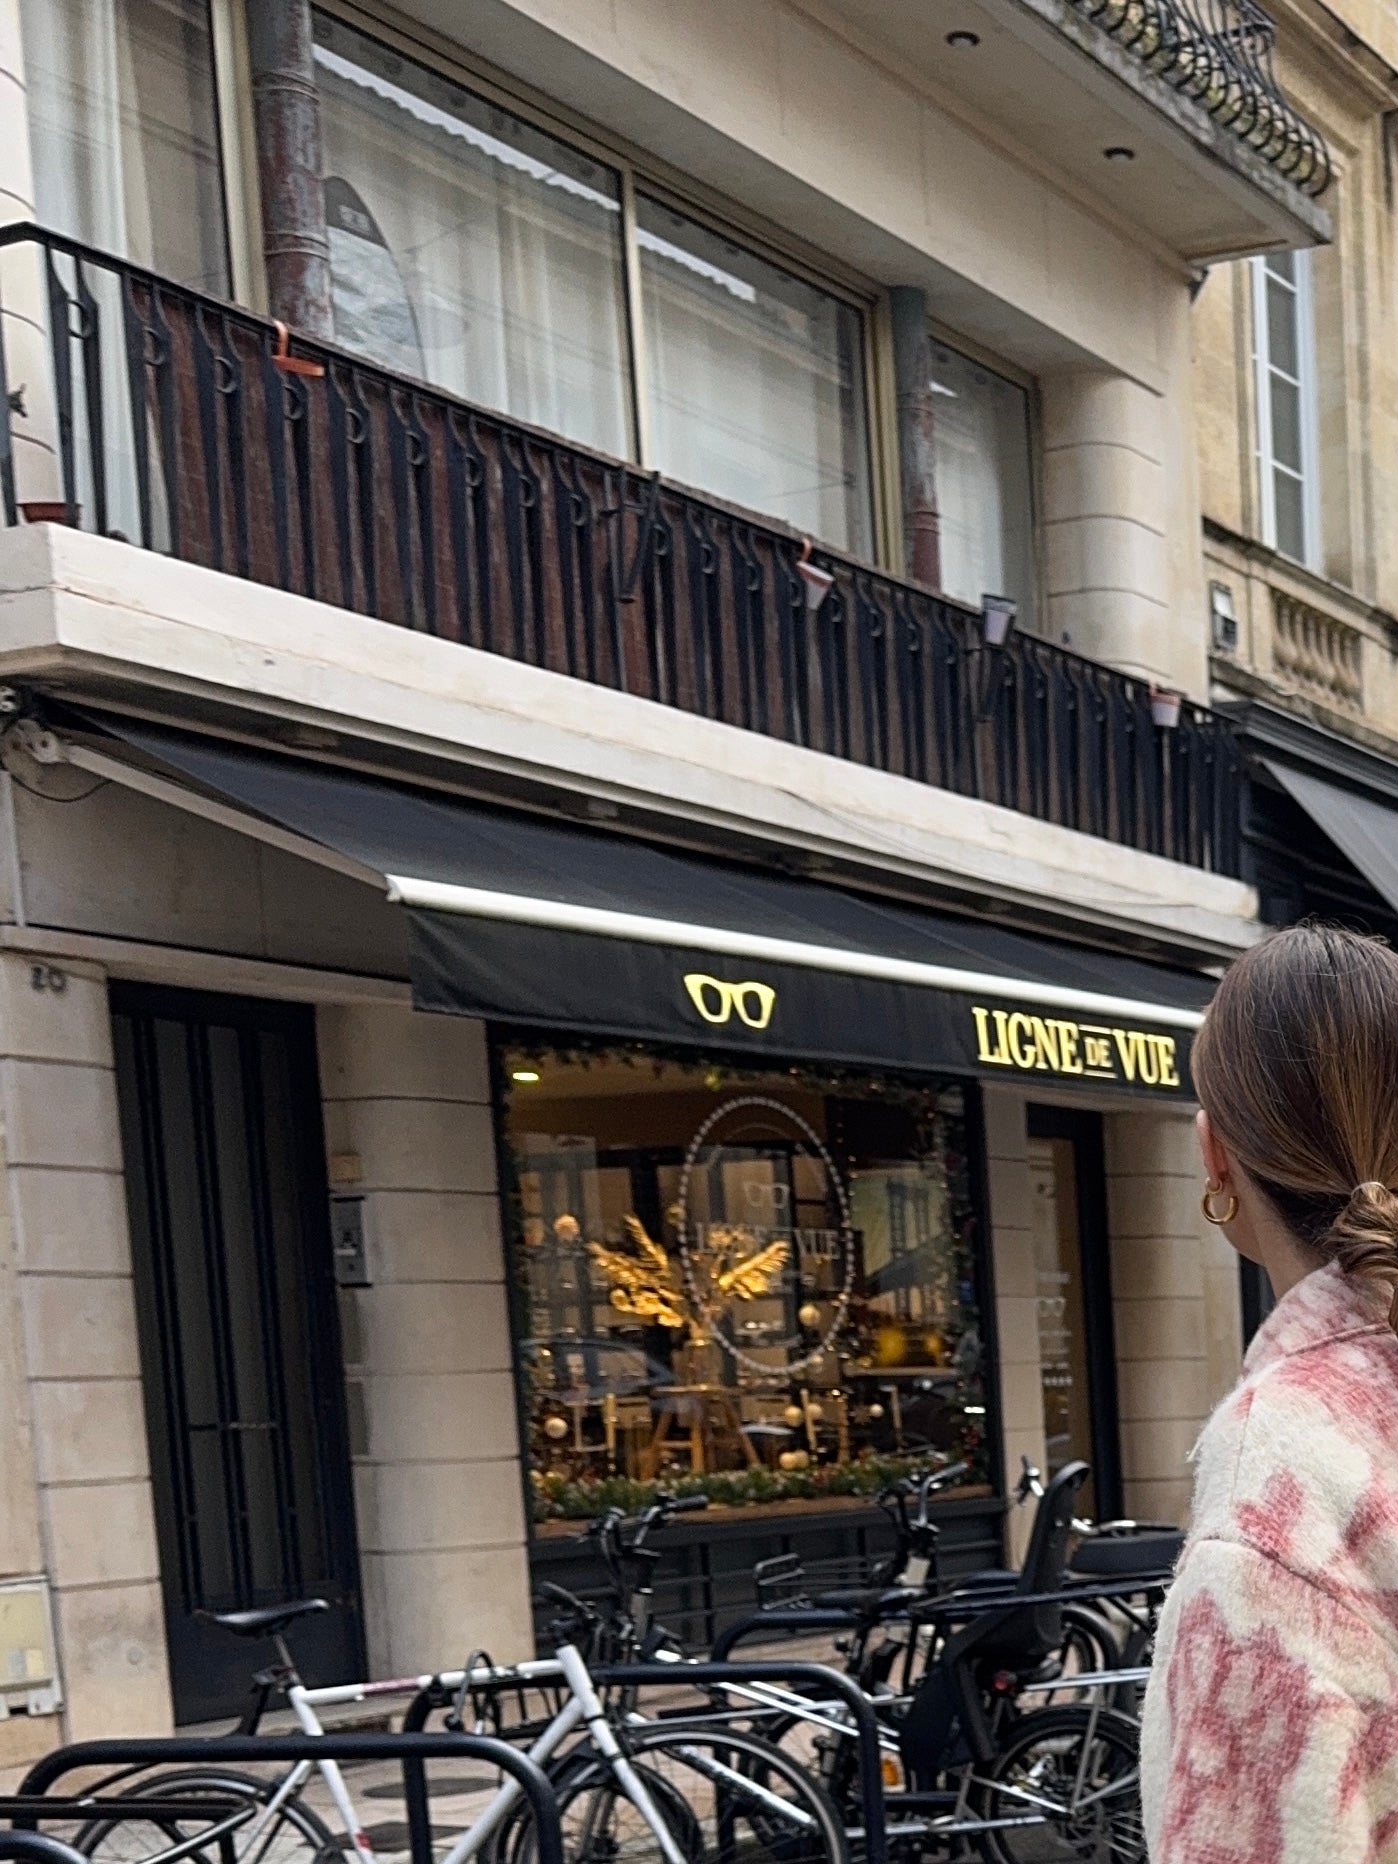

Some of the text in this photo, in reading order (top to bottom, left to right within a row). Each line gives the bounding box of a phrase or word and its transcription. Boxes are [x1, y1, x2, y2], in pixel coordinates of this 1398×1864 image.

[971, 1006, 1180, 1087] LIGNE DE VUE
